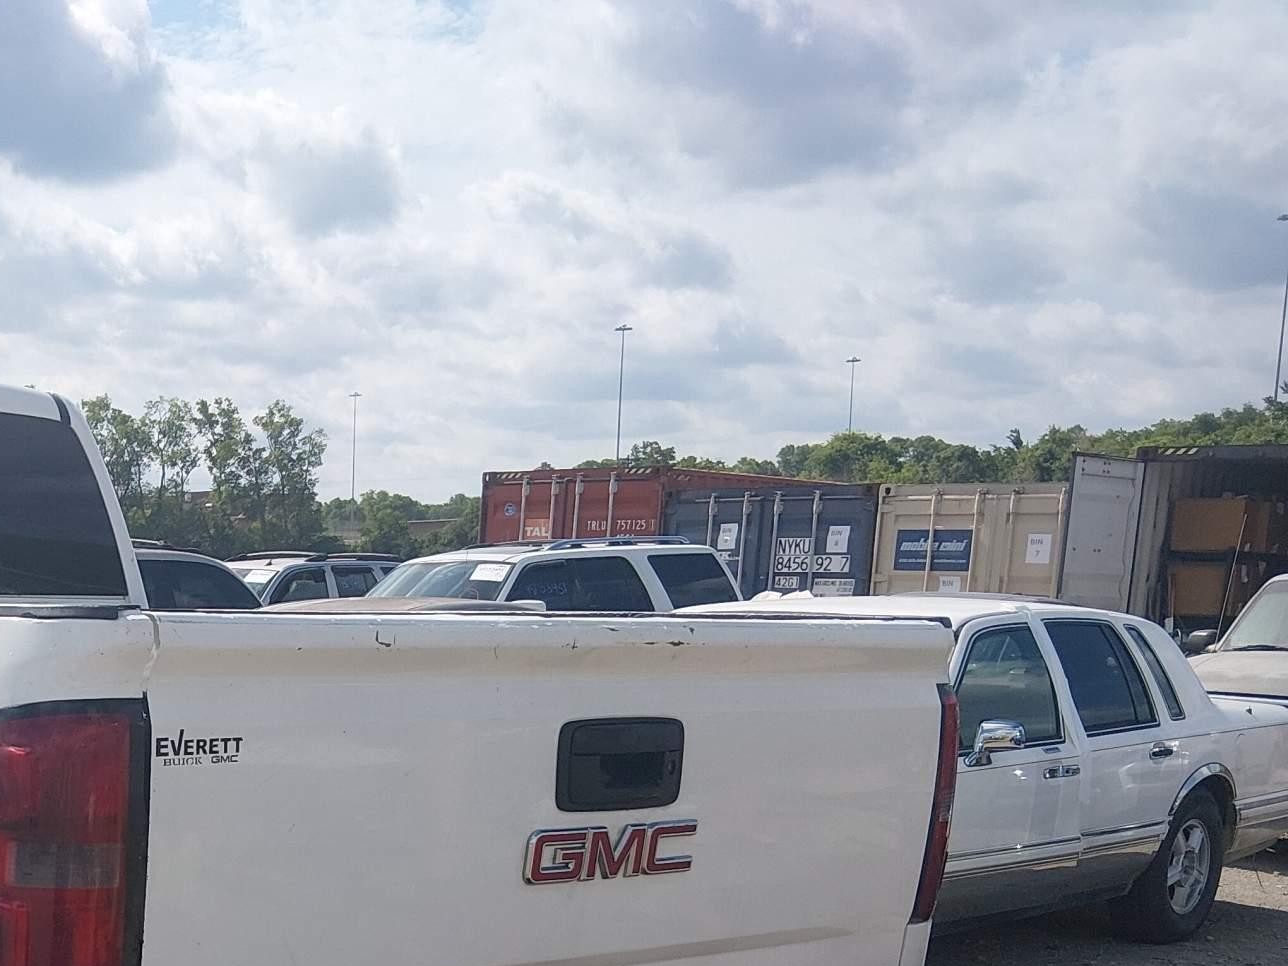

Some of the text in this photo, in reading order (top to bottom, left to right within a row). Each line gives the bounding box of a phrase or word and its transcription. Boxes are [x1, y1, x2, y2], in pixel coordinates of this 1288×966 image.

[525, 526, 549, 537] TAL
[587, 520, 607, 531] TRLU
[616, 519, 646, 530] 757125
[777, 539, 811, 555] NYKU
[1034, 549, 1041, 558] 7
[840, 556, 849, 572] 7
[155, 728, 243, 757] EVERETT
[162, 754, 239, 767] BUICK GMC
[522, 818, 698, 885] GMC
